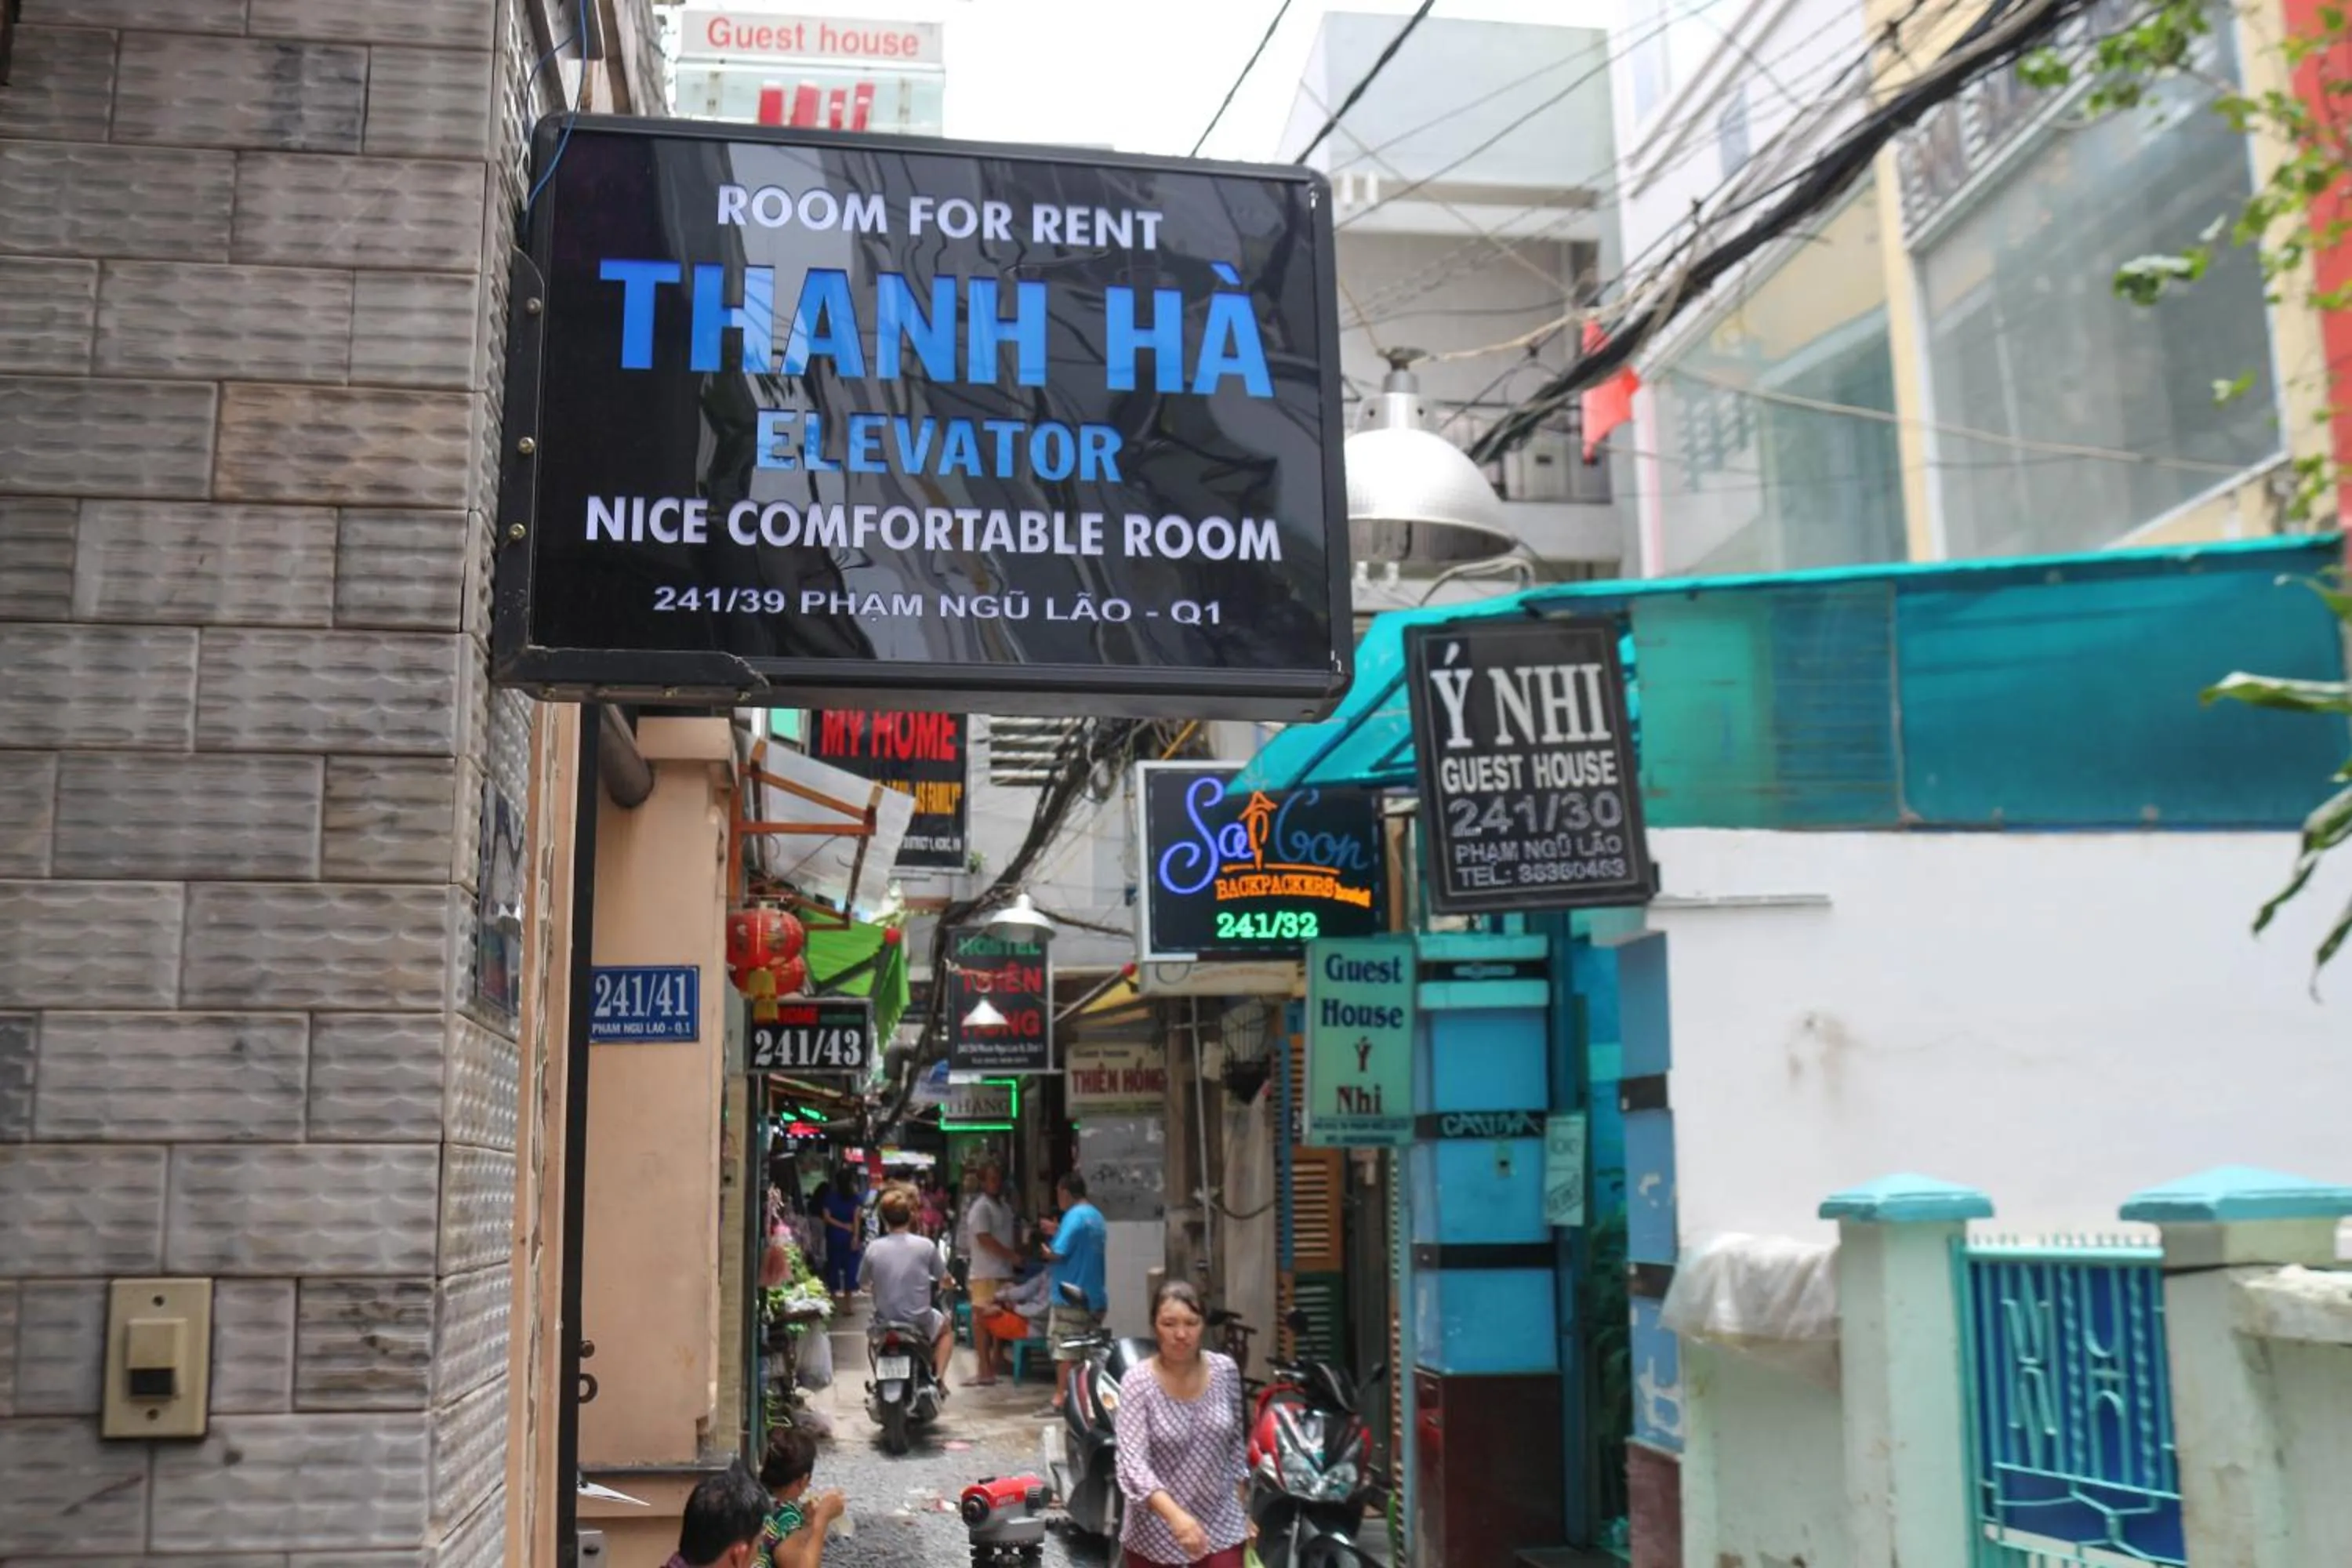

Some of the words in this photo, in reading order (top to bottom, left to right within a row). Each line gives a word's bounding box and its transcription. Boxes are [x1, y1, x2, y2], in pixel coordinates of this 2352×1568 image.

[707, 17, 805, 50] Guest
[820, 25, 919, 56] house
[717, 185, 887, 233] ROOM
[909, 197, 1011, 240] FOR
[1033, 204, 1162, 250] RENT
[599, 259, 1046, 387] THANH
[1105, 263, 1272, 397] HÀ
[756, 409, 1122, 482] ELEVATOR
[586, 496, 706, 543] NICE
[728, 500, 1102, 554] COMFORTABLE
[1124, 514, 1281, 561] ROOM
[653, 586, 785, 612] 241/39
[800, 591, 924, 621] PHẠM
[941, 588, 1030, 620] NGŨ
[1046, 592, 1131, 621] LÃO
[1171, 600, 1221, 625] Q1
[1430, 641, 1473, 749] Ý
[1487, 663, 1612, 746] NHI
[821, 710, 863, 756] MY
[871, 710, 956, 760] HOME
[1441, 754, 1524, 786] GUEST
[1532, 750, 1618, 781] HOUSE
[1449, 791, 1623, 837] 241/30
[1456, 863, 1512, 887] TEL:
[1216, 911, 1318, 938] 241/32
[1325, 953, 1403, 983] Guest
[594, 974, 690, 1017] 241/41
[1321, 998, 1404, 1029] House
[755, 1029, 861, 1065] 241/43
[1337, 1083, 1383, 1116] Nhi
